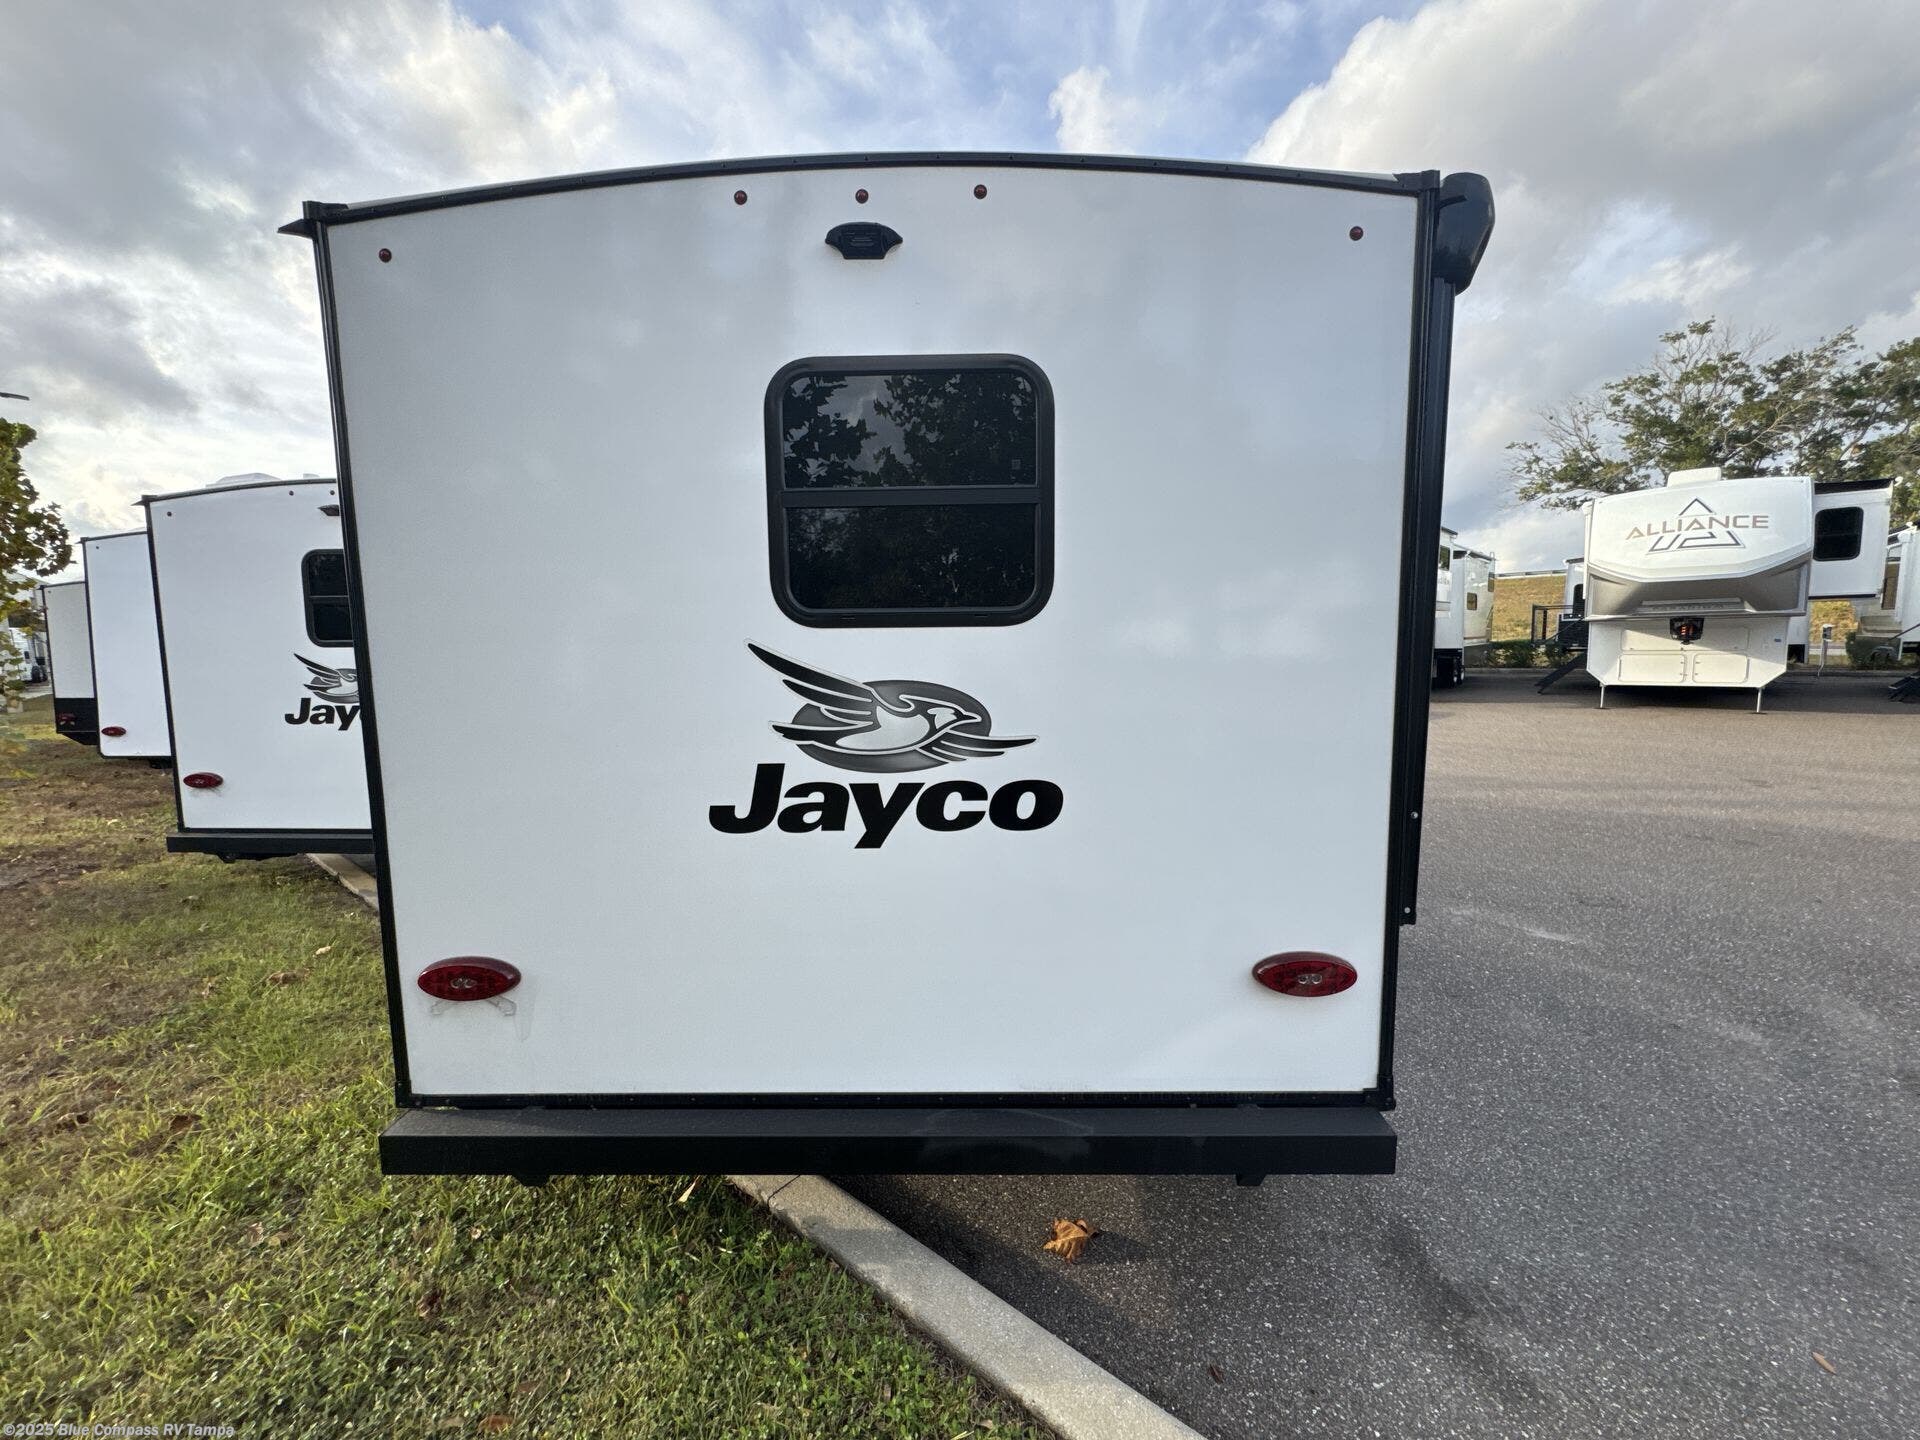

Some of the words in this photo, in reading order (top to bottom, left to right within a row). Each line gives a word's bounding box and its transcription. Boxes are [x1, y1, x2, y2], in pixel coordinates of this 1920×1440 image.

[1626, 515, 1769, 540] ALLIANCE
[284, 697, 360, 731] Jay
[709, 763, 1064, 849] Jayco
